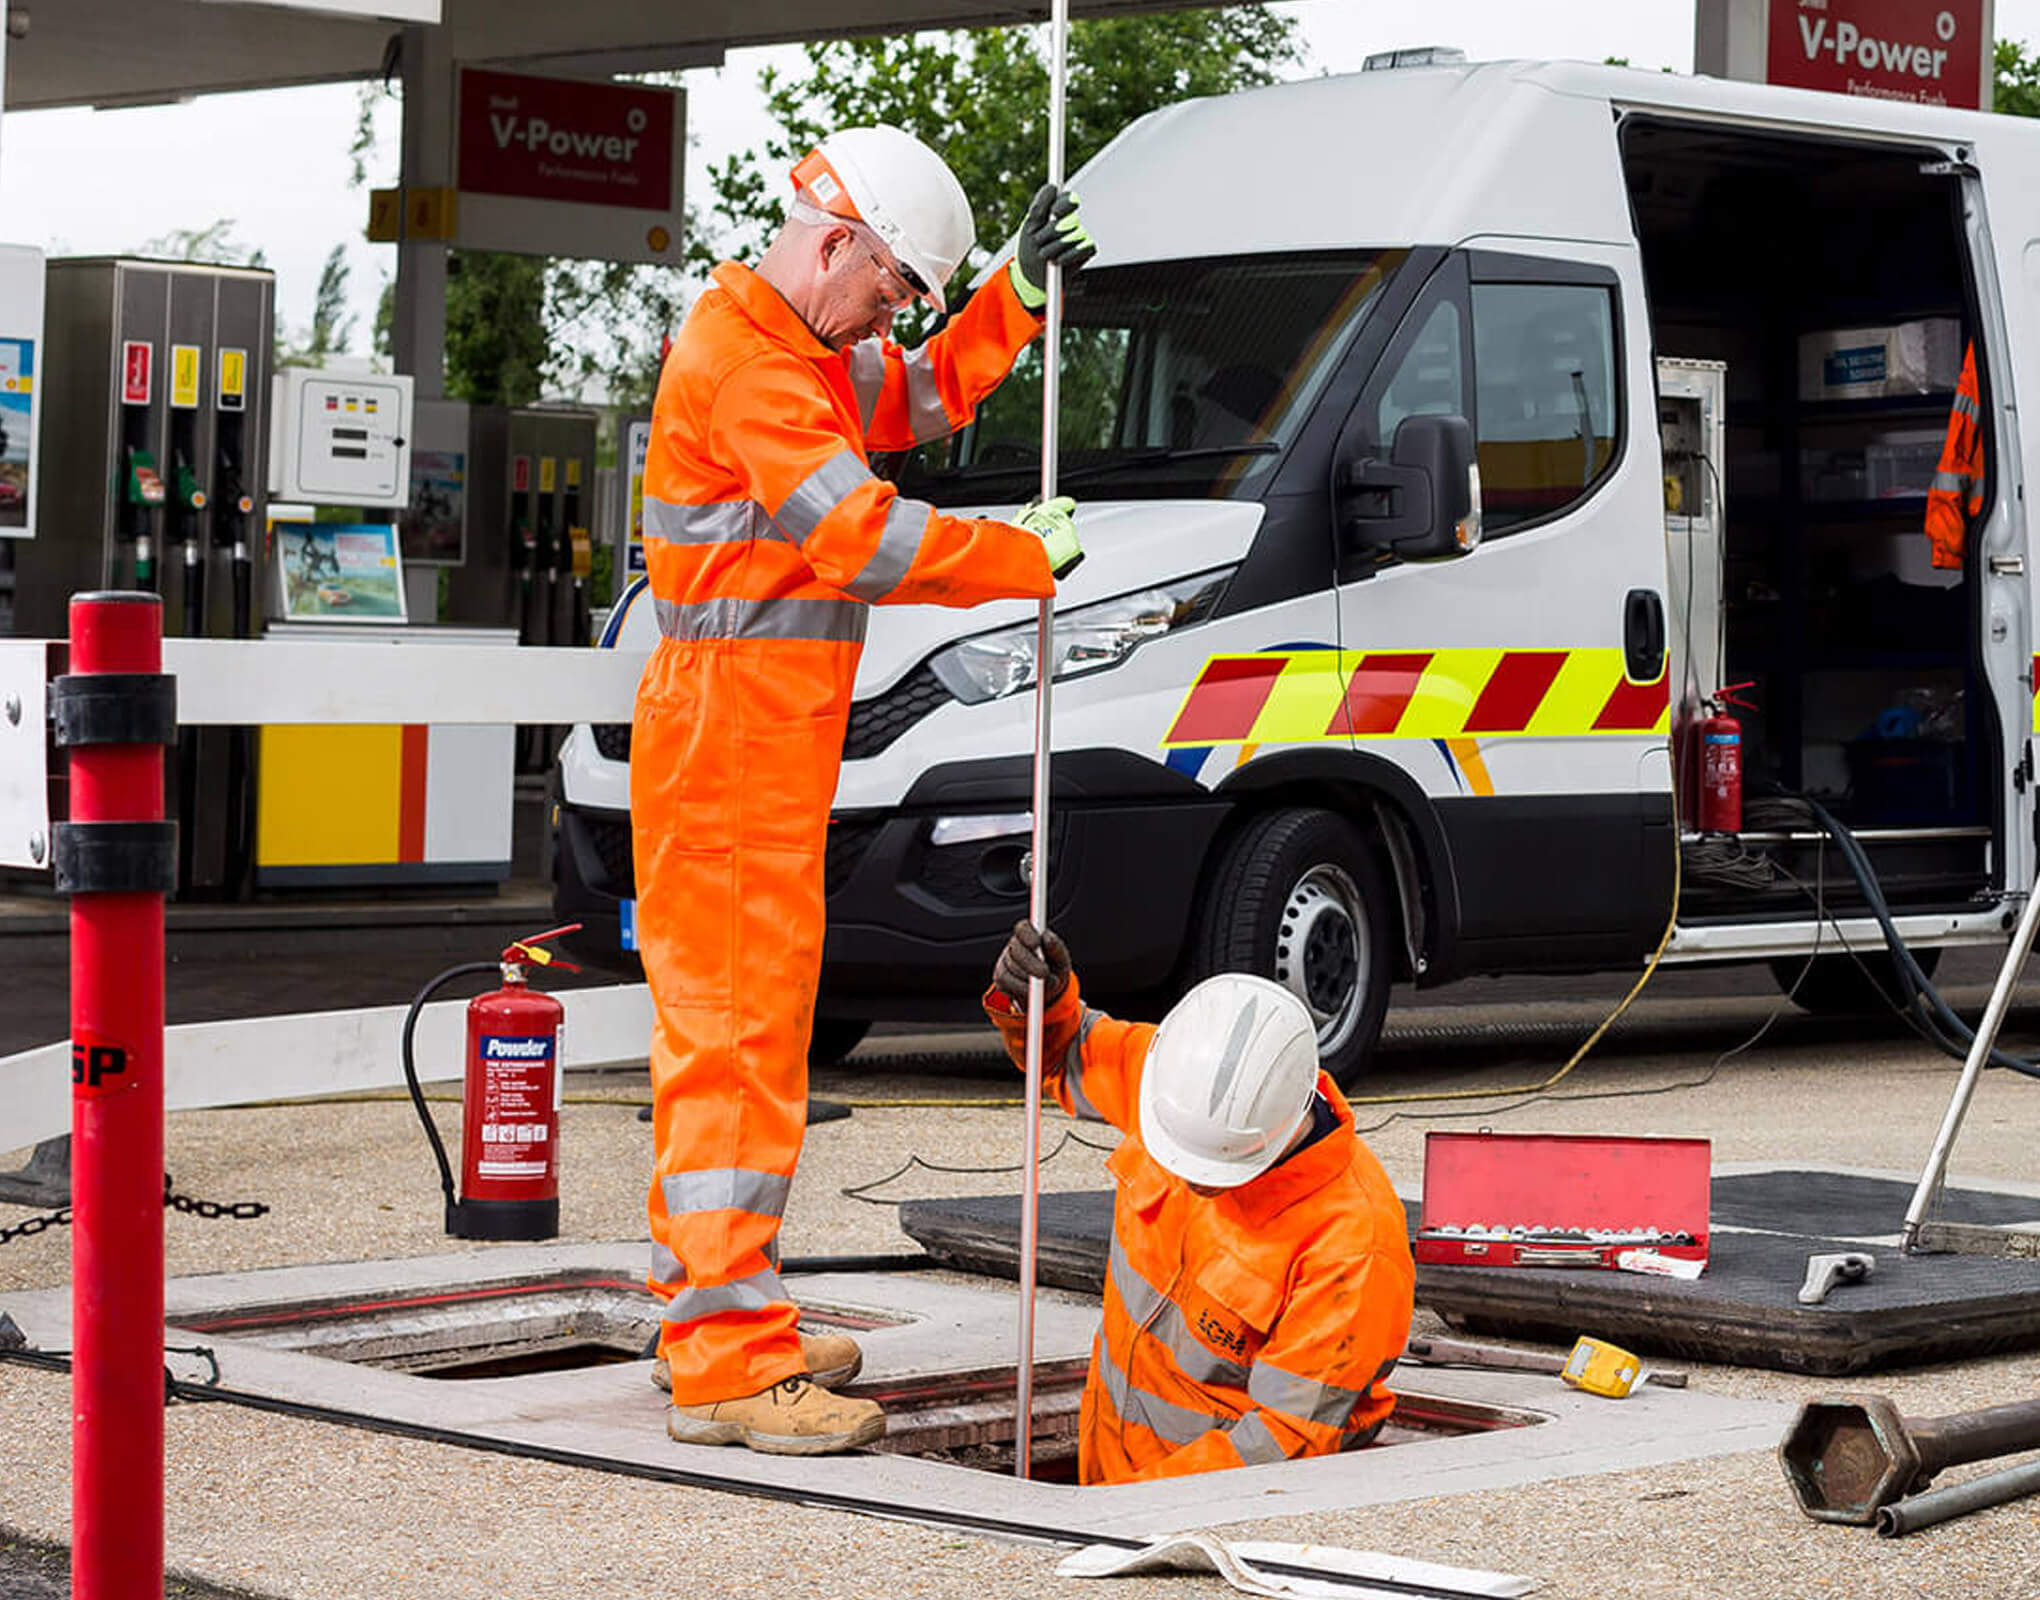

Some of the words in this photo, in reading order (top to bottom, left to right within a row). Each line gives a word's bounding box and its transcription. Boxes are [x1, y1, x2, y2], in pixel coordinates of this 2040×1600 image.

[1798, 14, 1948, 79] V-Power
[490, 114, 639, 162] V-Power
[487, 1038, 548, 1057] Powder
